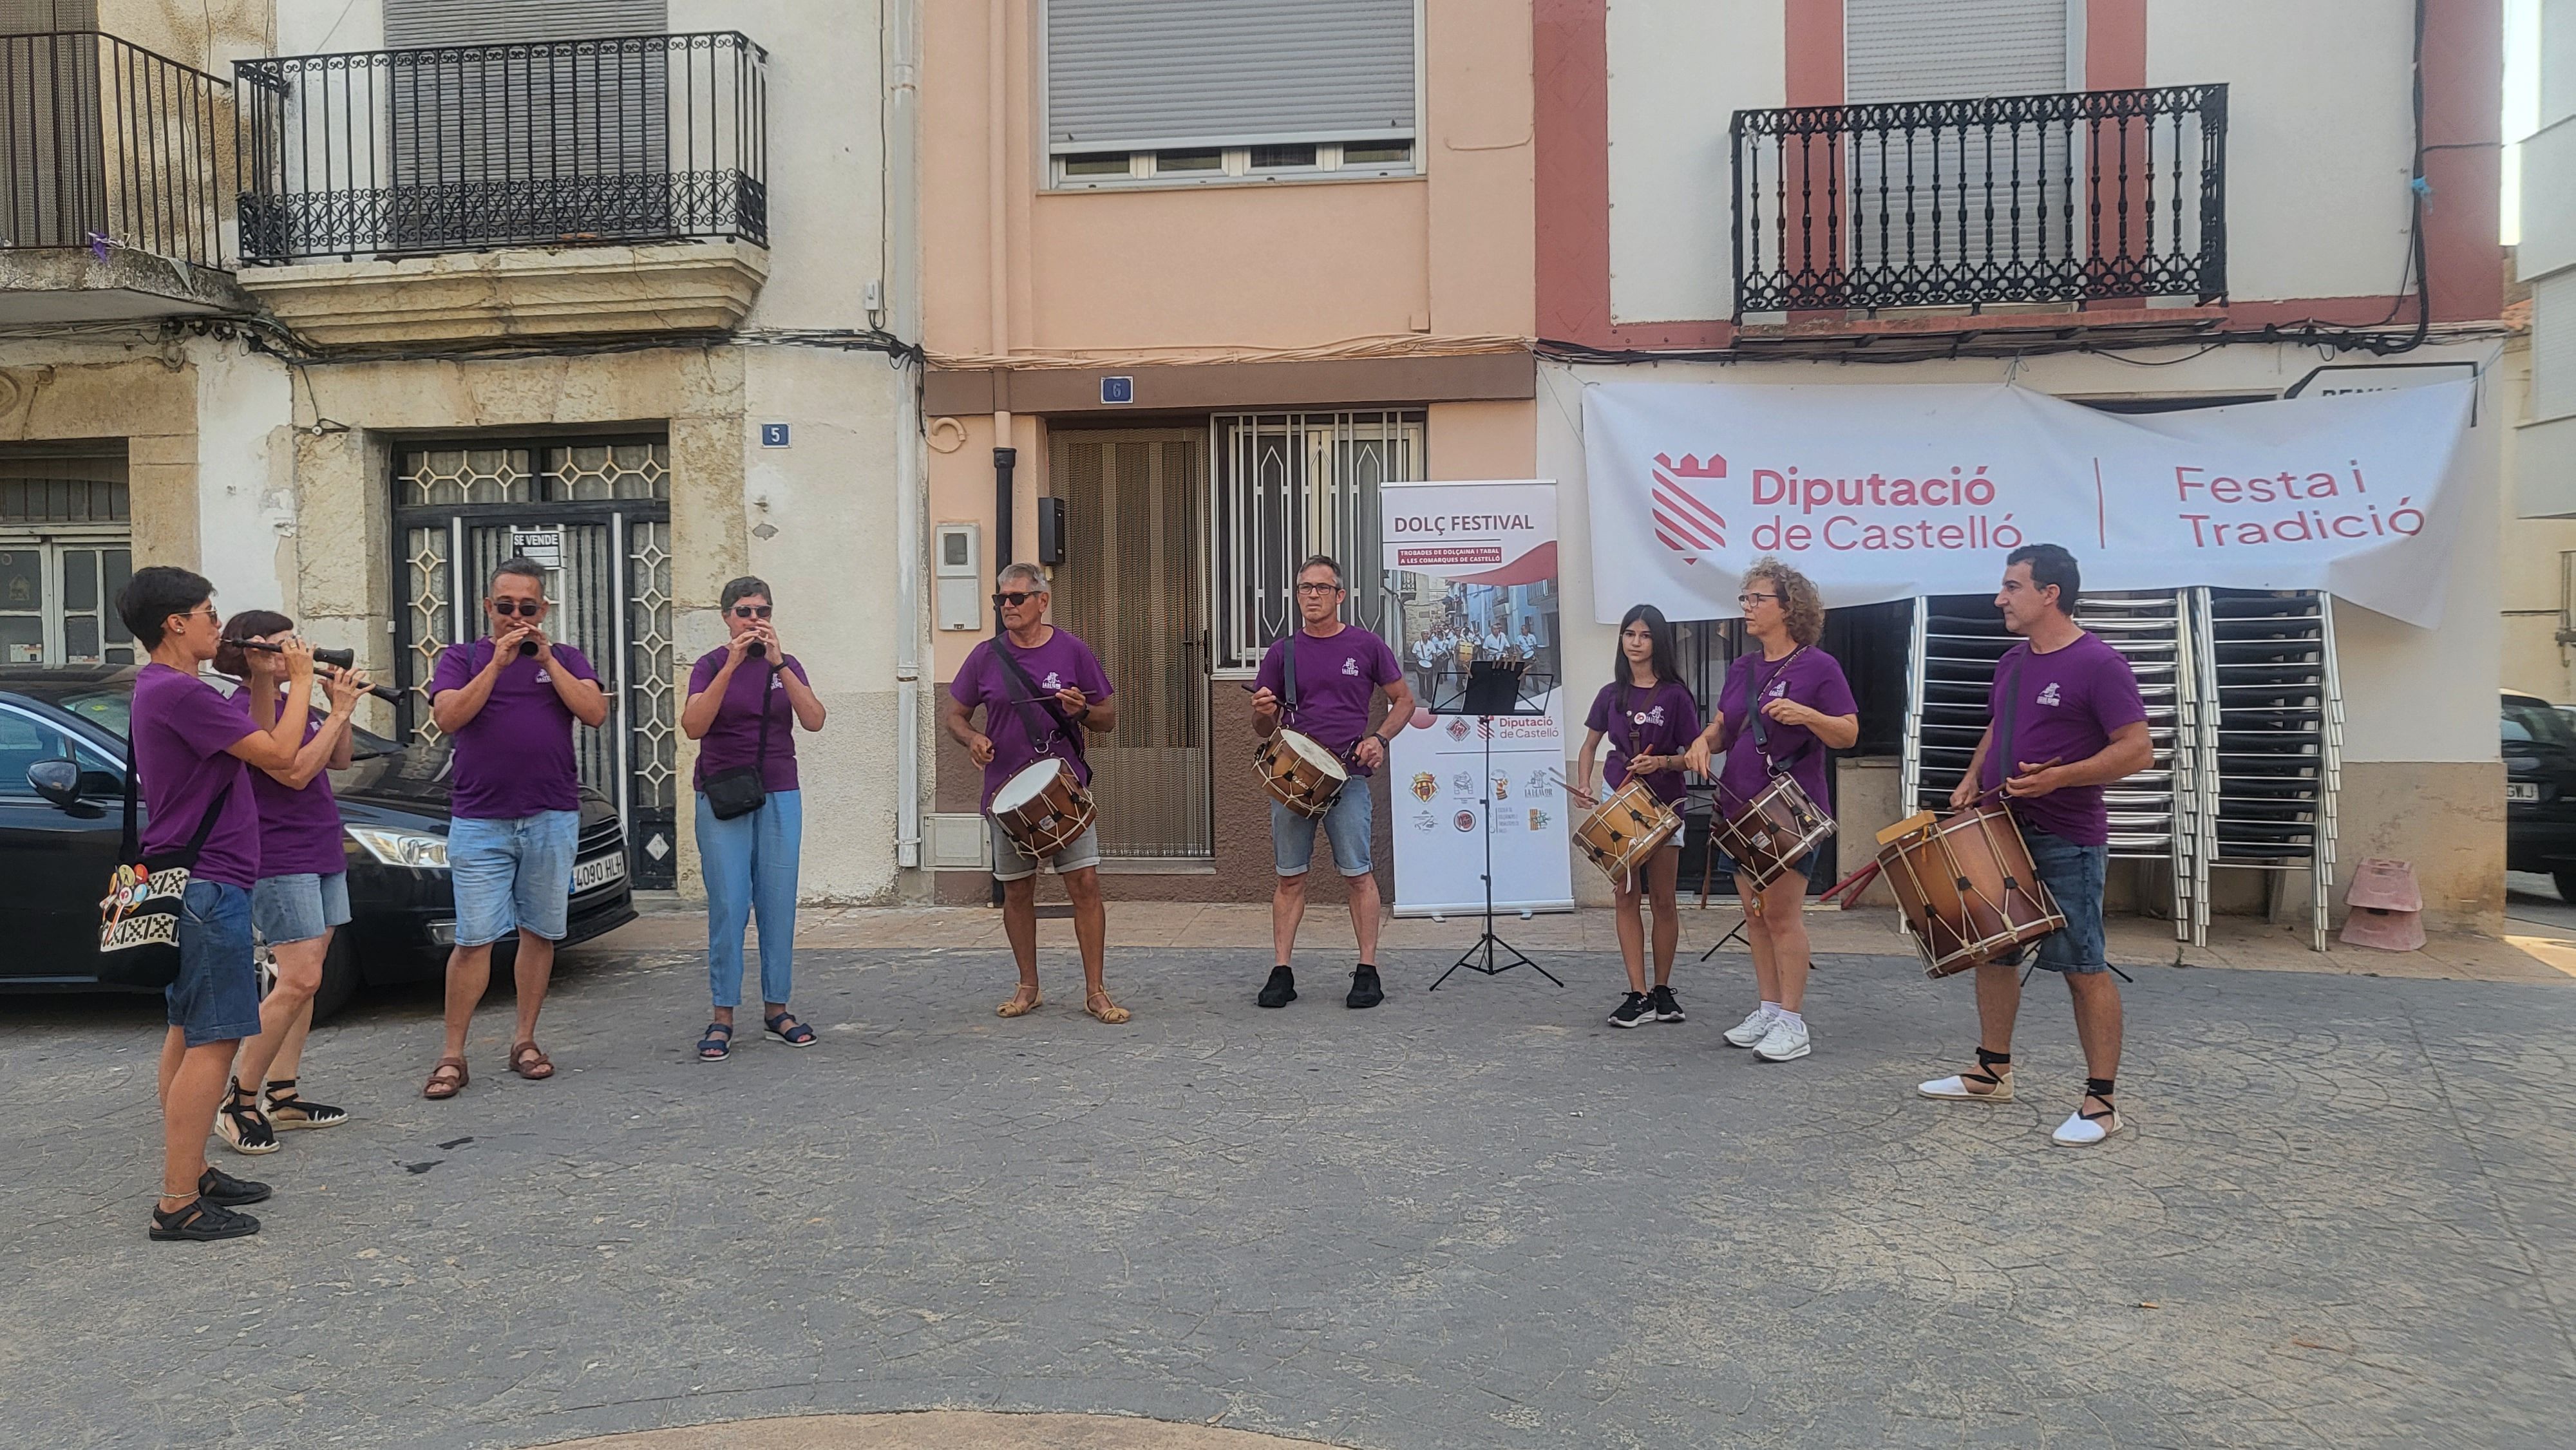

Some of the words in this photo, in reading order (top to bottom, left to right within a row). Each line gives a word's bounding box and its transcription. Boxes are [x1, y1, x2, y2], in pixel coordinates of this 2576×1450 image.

[1113, 383, 1121, 398] 6
[770, 427, 781, 442] 5
[1751, 465, 1996, 514] Diputació
[2175, 466, 2339, 504] Festa
[2351, 459, 2367, 493] i
[1394, 516, 1446, 536] DOLÇ
[1451, 514, 1535, 531] FESTIVAL
[1752, 515, 1812, 551] de
[1823, 513, 2023, 551] Castelló
[2179, 496, 2425, 548] Tradició
[514, 534, 524, 546] SE
[526, 534, 558, 546] VENDE
[1499, 715, 1553, 730] Diputació
[1500, 730, 1514, 739] de
[1515, 727, 1559, 738] Castelló
[576, 862, 603, 888] 4090
[605, 854, 623, 878] HLH
